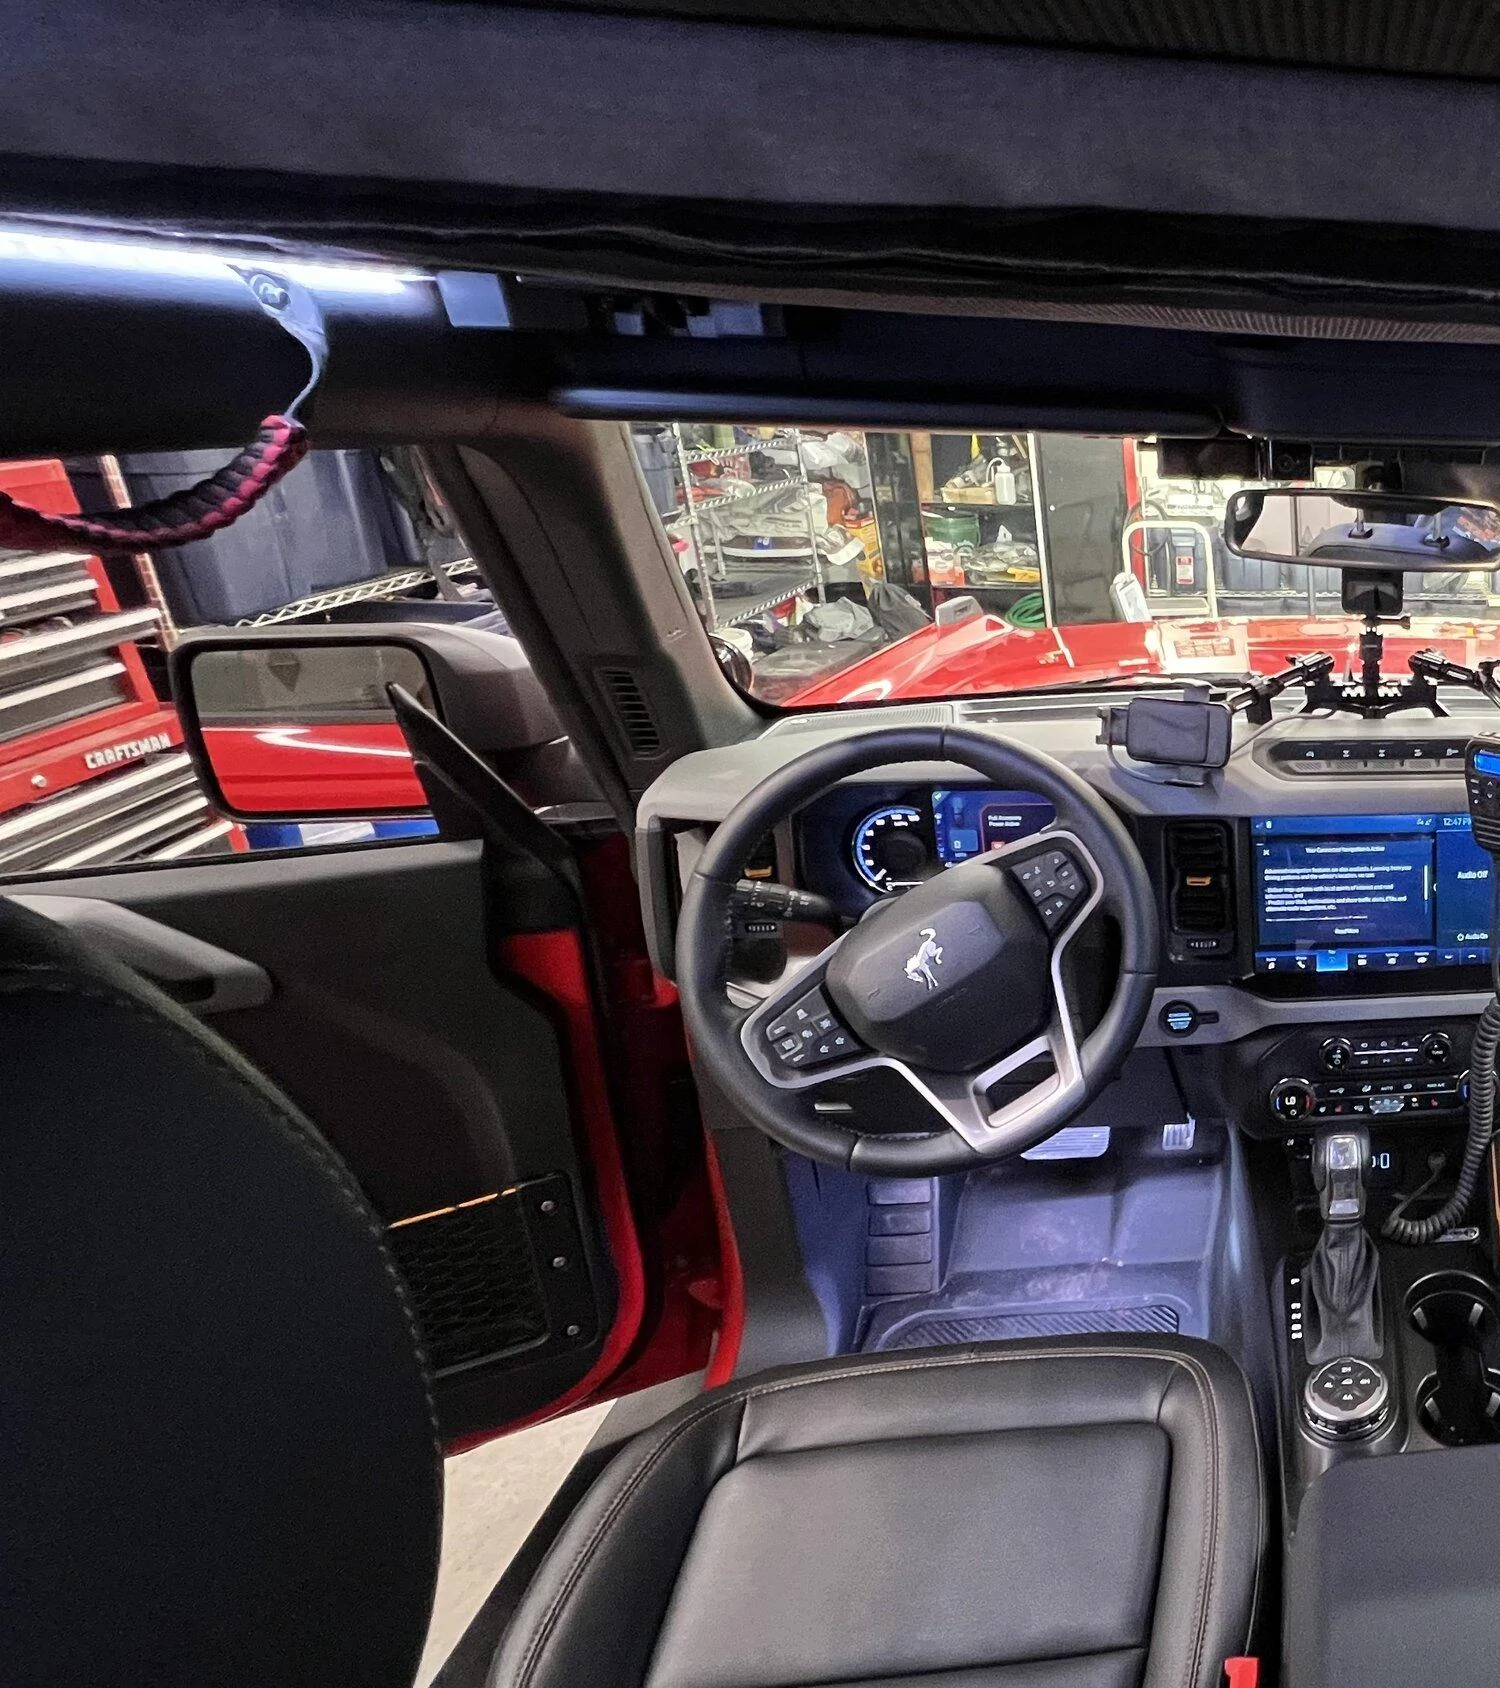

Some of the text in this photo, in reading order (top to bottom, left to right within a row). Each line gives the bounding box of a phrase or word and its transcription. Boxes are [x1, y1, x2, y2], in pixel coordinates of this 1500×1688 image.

[85, 733, 171, 769] CRAFTSMAN
[1443, 818, 1461, 826] 12:47
[1457, 870, 1488, 879] Audio Off
